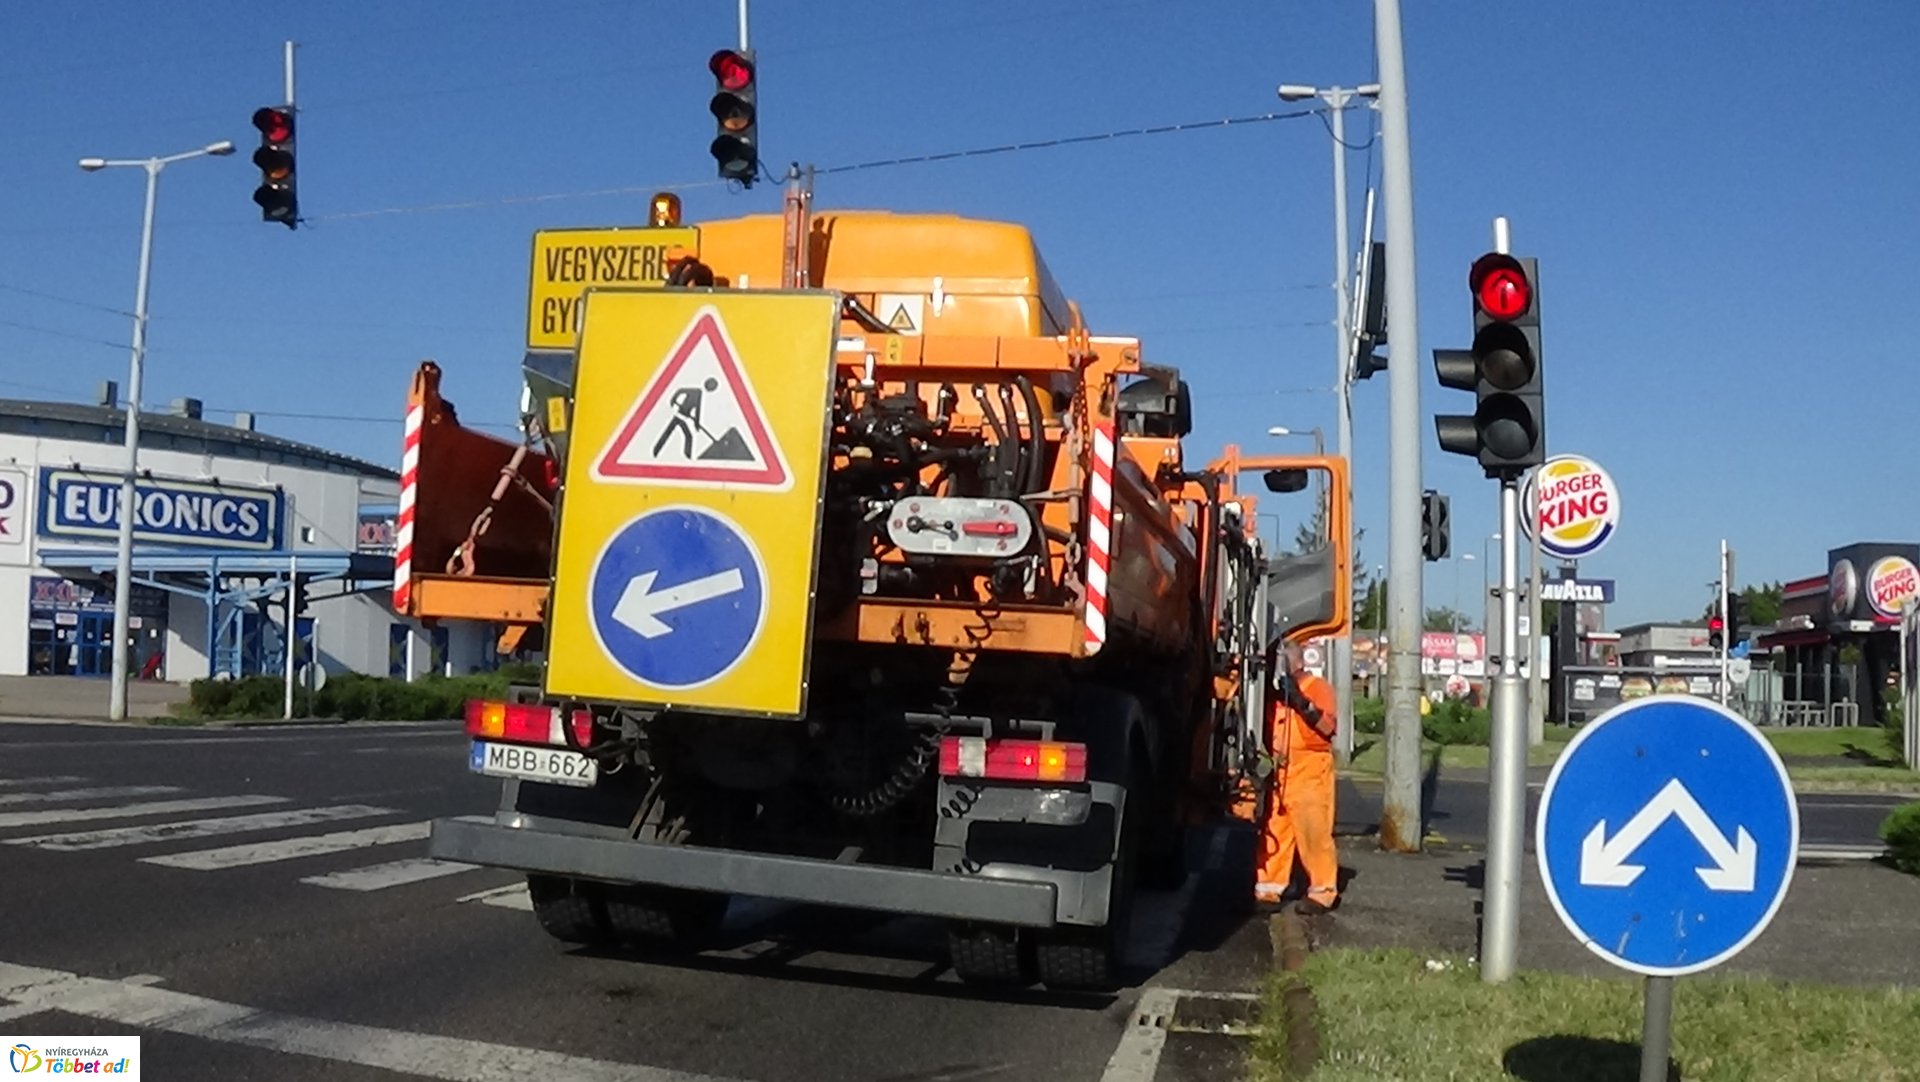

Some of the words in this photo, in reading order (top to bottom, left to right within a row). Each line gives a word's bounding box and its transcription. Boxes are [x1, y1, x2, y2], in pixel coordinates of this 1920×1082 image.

[546, 245, 683, 282] VEGYSZERE
[64, 485, 260, 537] EURONICS
[1539, 491, 1608, 533] KING
[1877, 578, 1916, 605] KING
